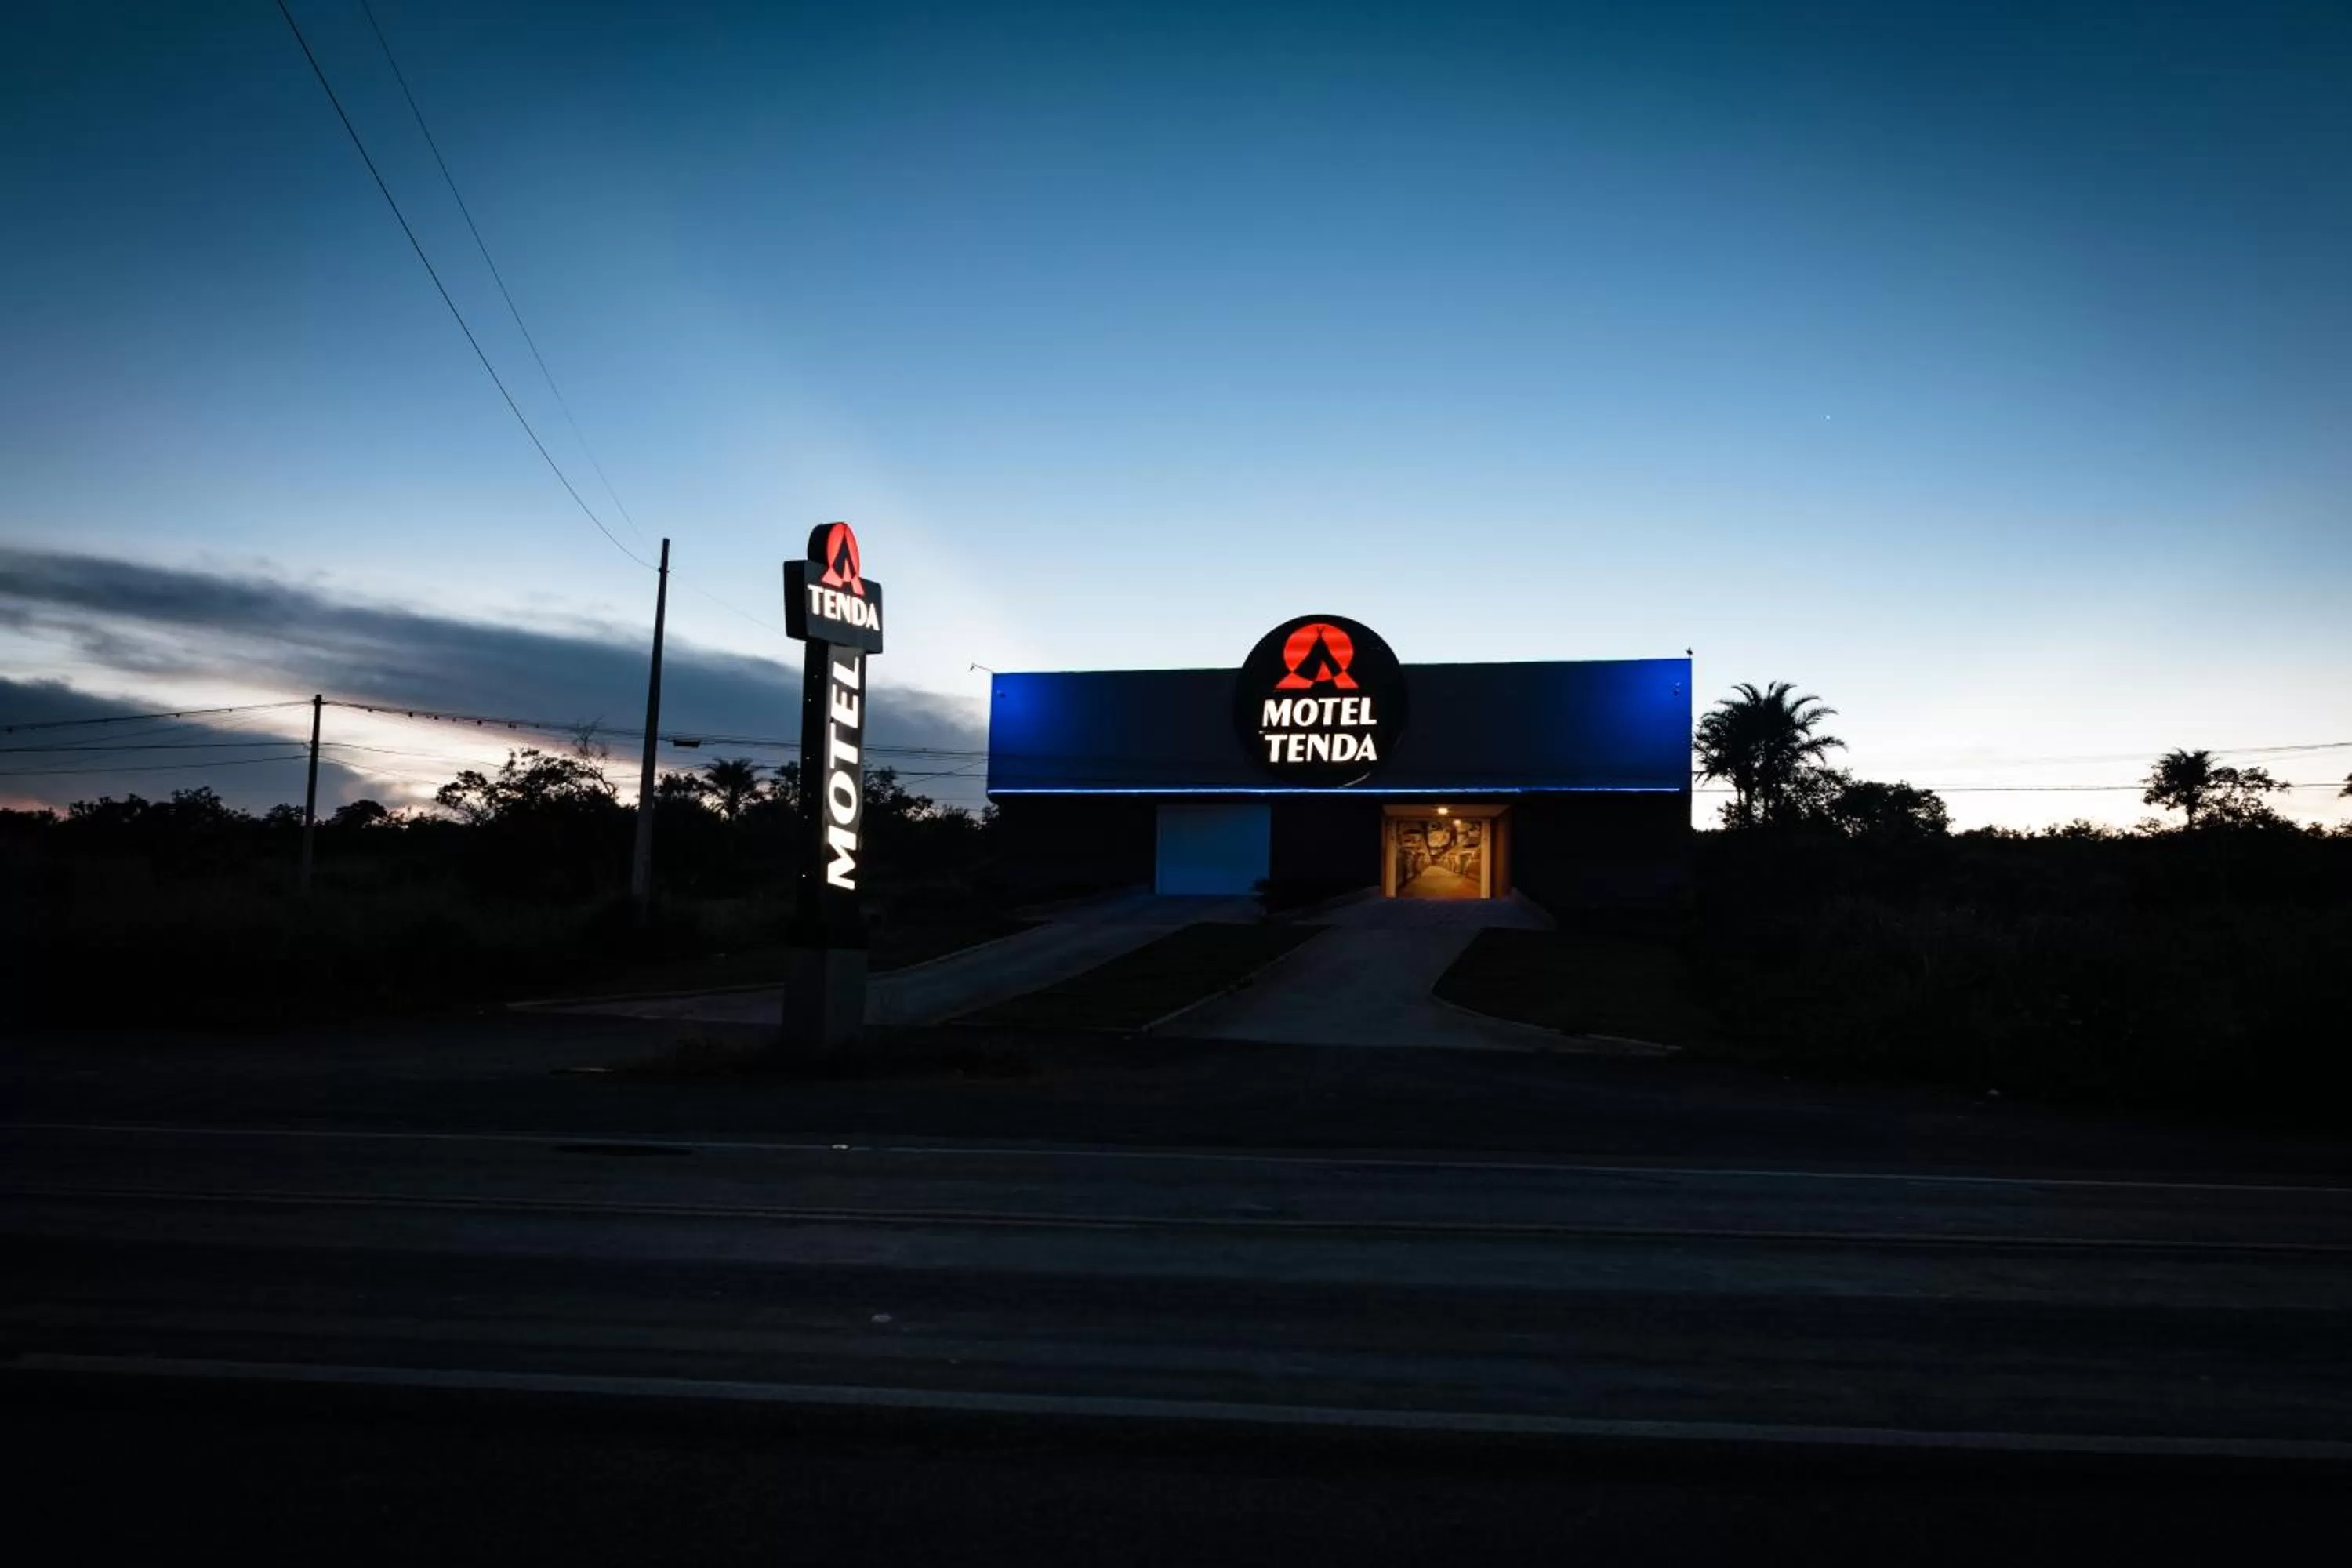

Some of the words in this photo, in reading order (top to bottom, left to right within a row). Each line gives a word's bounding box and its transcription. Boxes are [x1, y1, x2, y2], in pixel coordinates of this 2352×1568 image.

[807, 584, 880, 631] TENDA
[1262, 697, 1377, 727] MOTEL
[1265, 733, 1377, 763] TENDA
[828, 656, 859, 890] MOTEL
